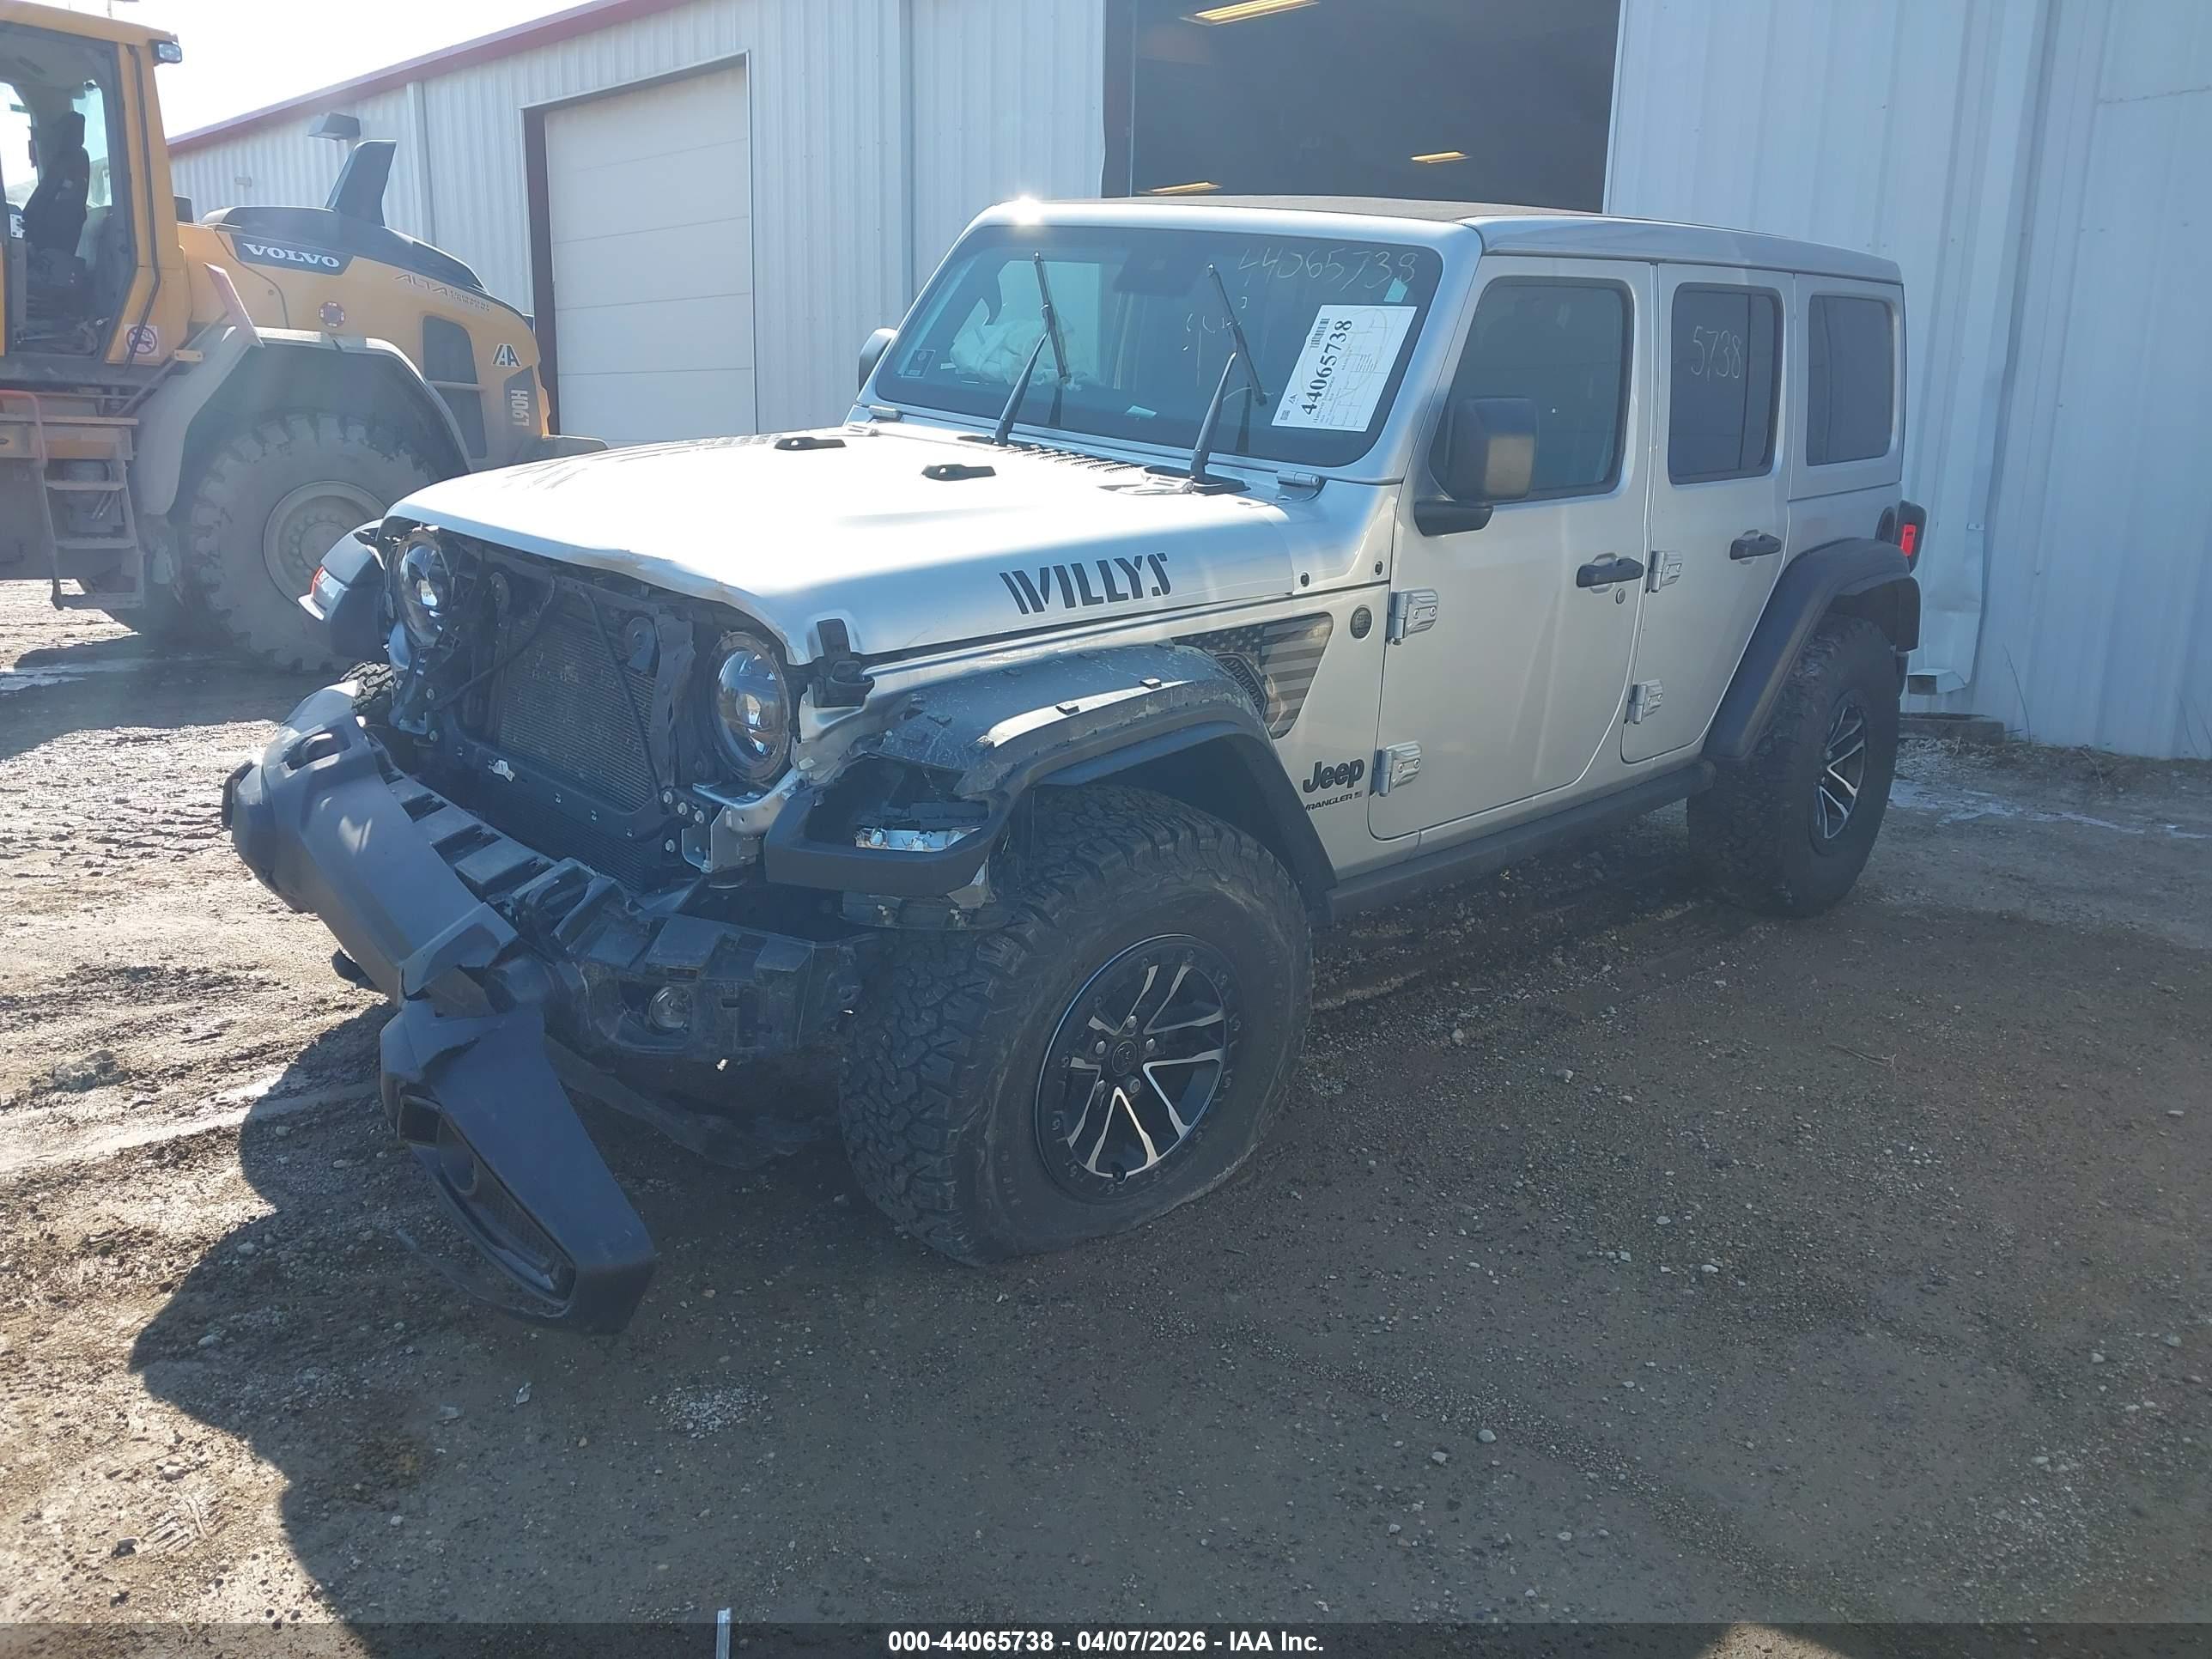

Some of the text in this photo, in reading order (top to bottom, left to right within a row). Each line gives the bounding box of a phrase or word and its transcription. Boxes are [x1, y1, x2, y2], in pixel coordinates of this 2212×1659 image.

[243, 243, 339, 268] VOLVO
[1301, 320, 1352, 415] 44065738
[1691, 325, 1741, 383] 5738
[510, 389, 530, 427] L90H
[1000, 552, 1171, 615] WILLYS
[1303, 759, 1364, 793] Jeep
